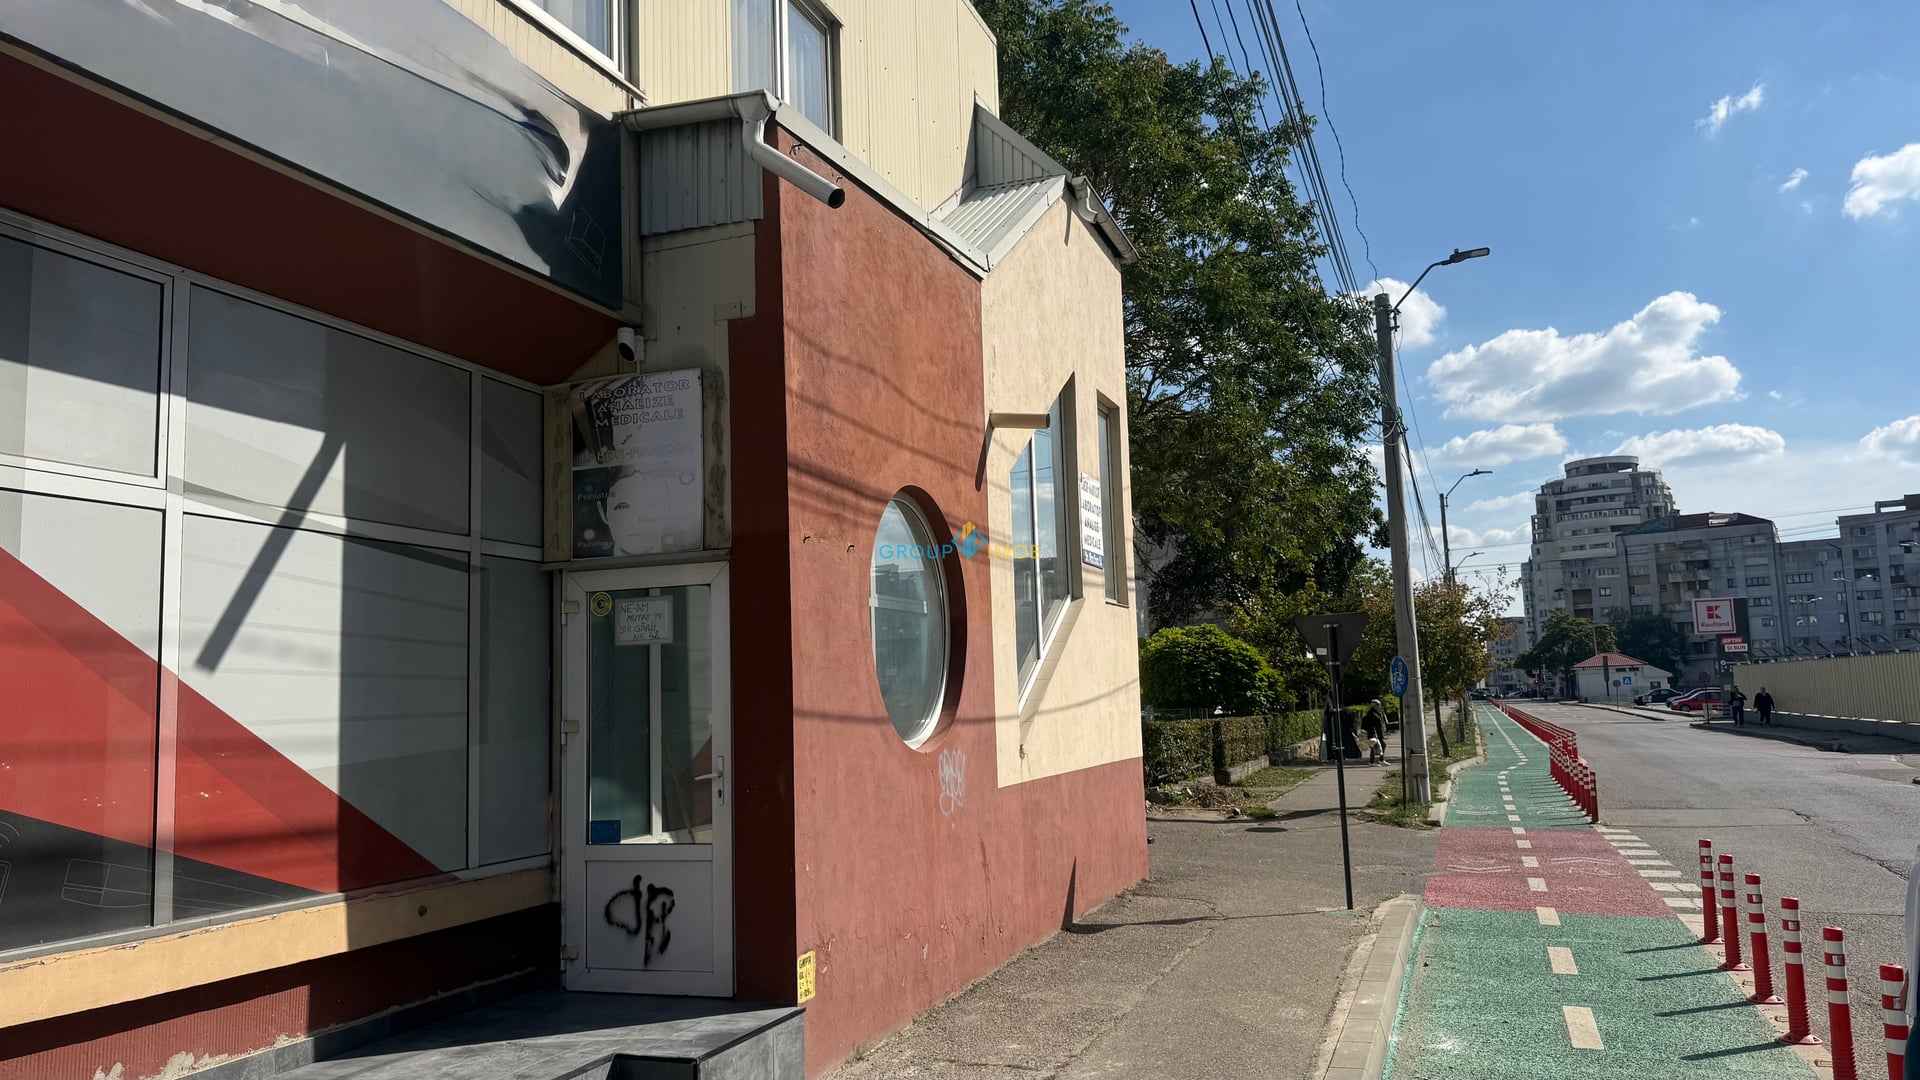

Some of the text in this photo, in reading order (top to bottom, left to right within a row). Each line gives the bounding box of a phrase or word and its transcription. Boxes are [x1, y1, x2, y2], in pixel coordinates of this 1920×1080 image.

[580, 379, 690, 402] LABORATOR
[597, 395, 674, 414] ANALIZE
[595, 408, 685, 428] MEDICALE
[620, 603, 649, 614] NE-AM
[627, 614, 649, 622] MUTAT
